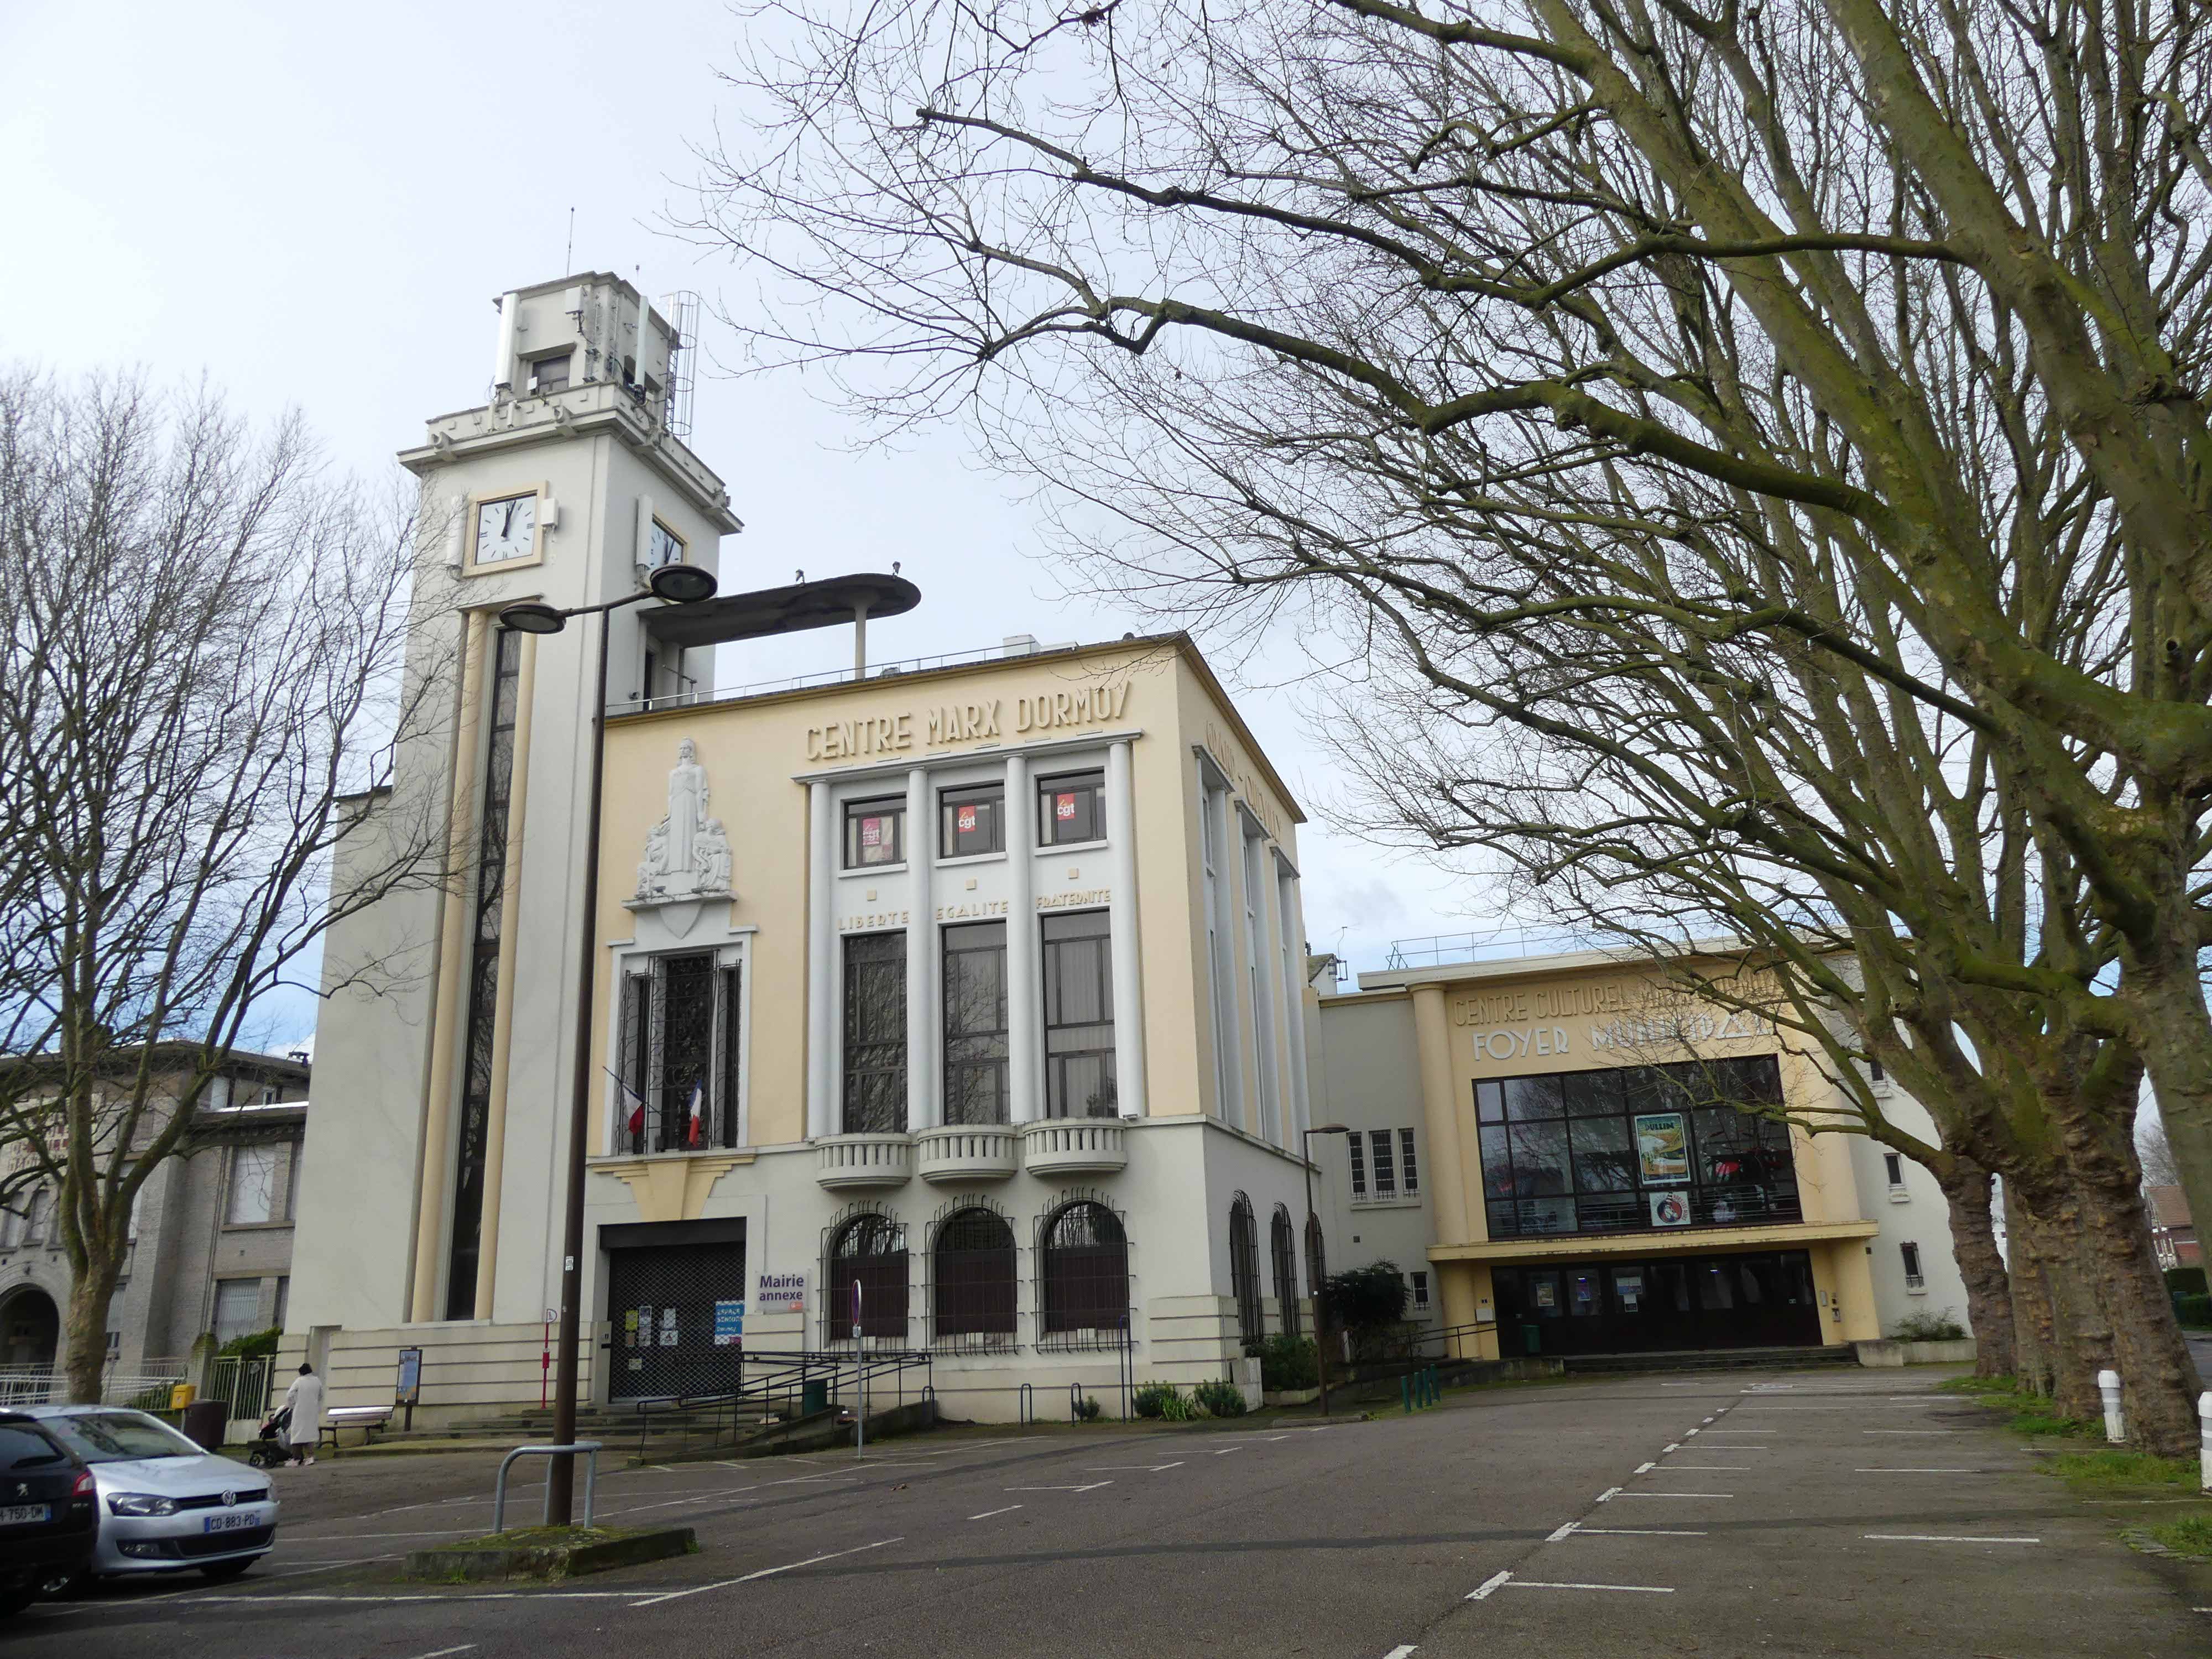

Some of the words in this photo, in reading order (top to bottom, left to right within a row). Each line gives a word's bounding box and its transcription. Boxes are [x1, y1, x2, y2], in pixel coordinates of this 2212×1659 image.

[807, 712, 912, 761] CENTRE
[927, 699, 1000, 744] MARX
[1016, 679, 1132, 732] DORMOY
[1057, 803, 1074, 816] cgt
[959, 816, 975, 828] cgt
[1036, 889, 1111, 909] FRATERNITE
[936, 900, 1009, 920] EGALITE
[838, 911, 909, 930] LIBERTE
[1454, 993, 1527, 1026] CENTRE
[1535, 982, 1631, 1018] CULTUREL
[1473, 1026, 1569, 1061] FOYER
[760, 1274, 804, 1288] Mairie
[759, 1291, 803, 1301] annexe
